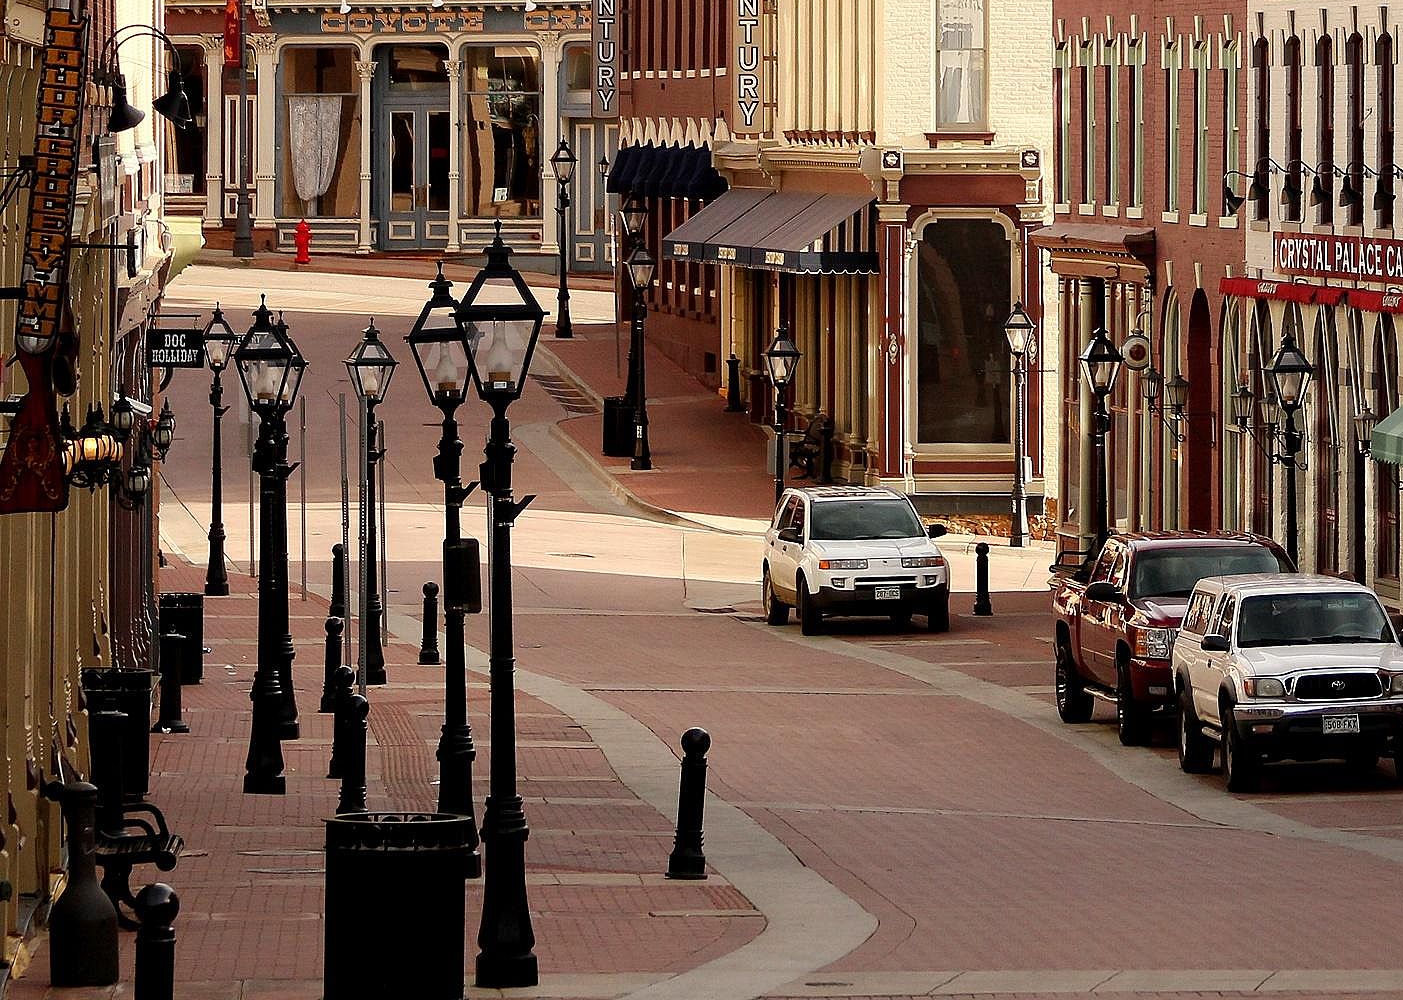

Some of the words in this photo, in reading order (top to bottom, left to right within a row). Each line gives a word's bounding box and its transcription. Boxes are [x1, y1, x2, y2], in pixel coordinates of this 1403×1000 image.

[320, 11, 484, 32] COYOTE
[30, 139, 75, 270] GROCERY
[1279, 238, 1332, 271] CRYSTAL
[1334, 242, 1382, 276] PALACE
[164, 334, 187, 347] DOC
[152, 349, 199, 363] HOLLIDAY
